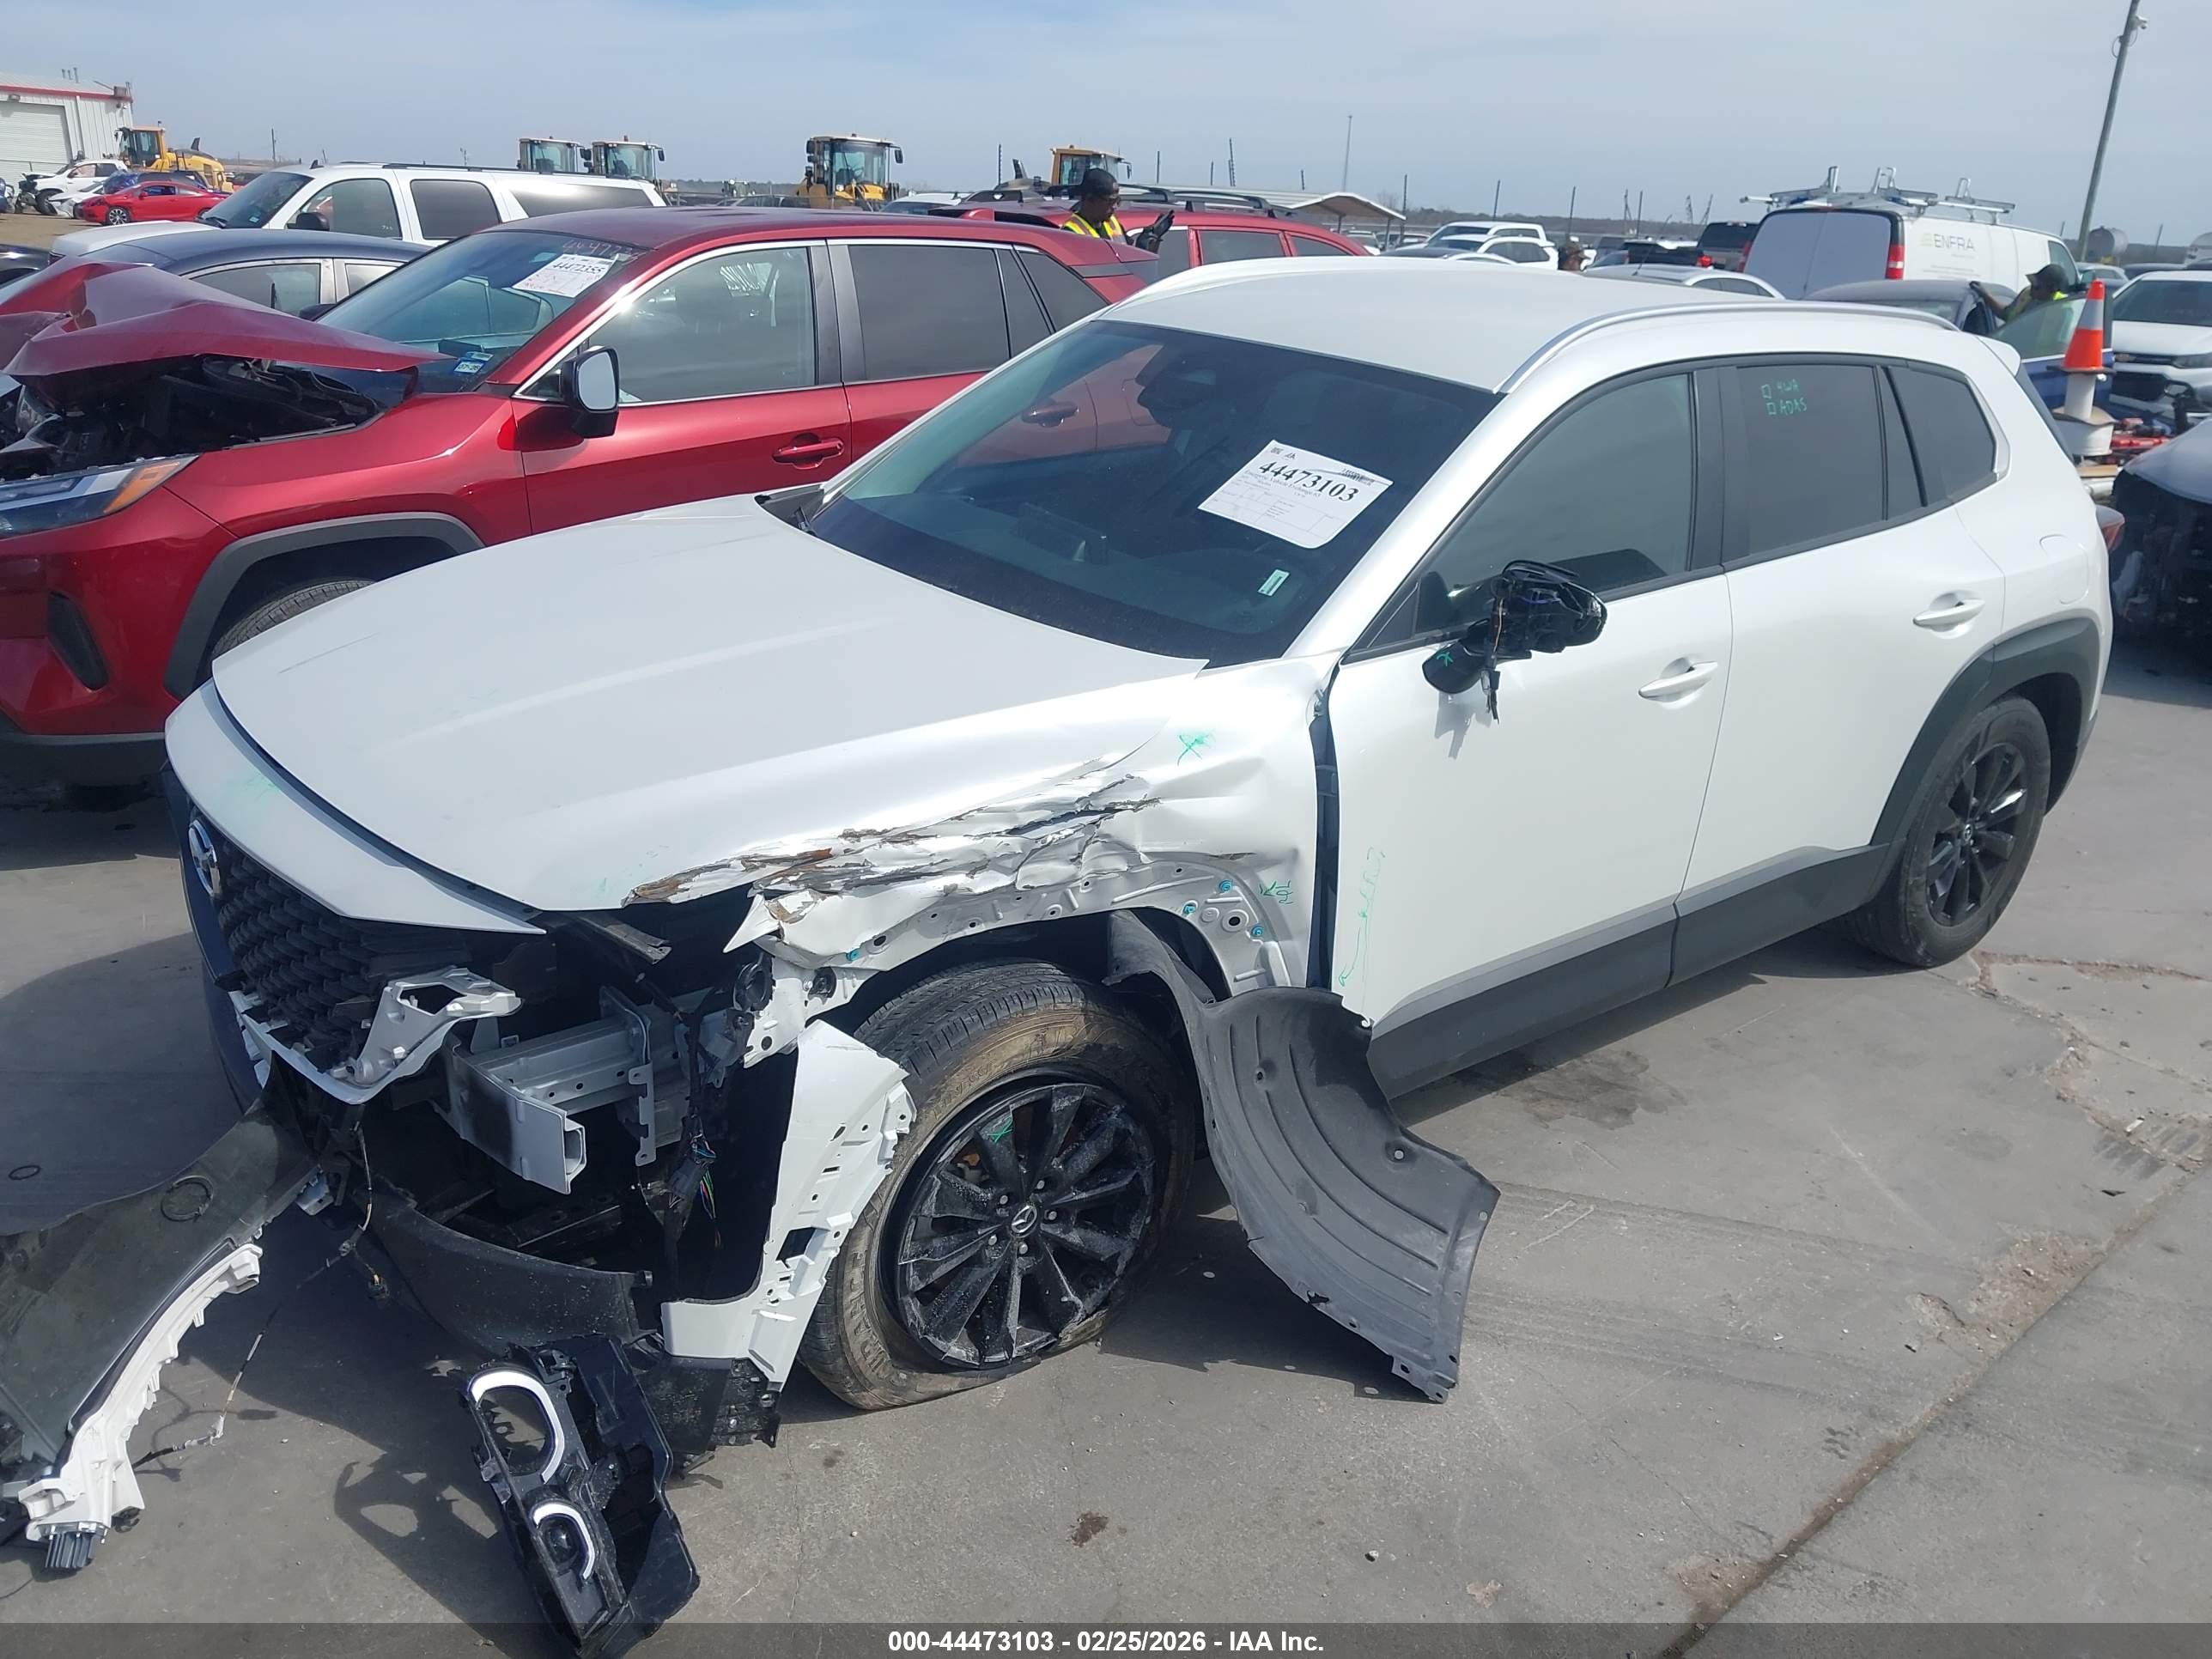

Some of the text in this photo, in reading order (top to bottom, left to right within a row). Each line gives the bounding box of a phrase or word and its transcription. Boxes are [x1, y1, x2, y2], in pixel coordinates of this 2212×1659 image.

[1933, 234, 1976, 252] ENFRA
[1780, 398, 1808, 416] ADAS
[1259, 461, 1359, 502] 44473103
